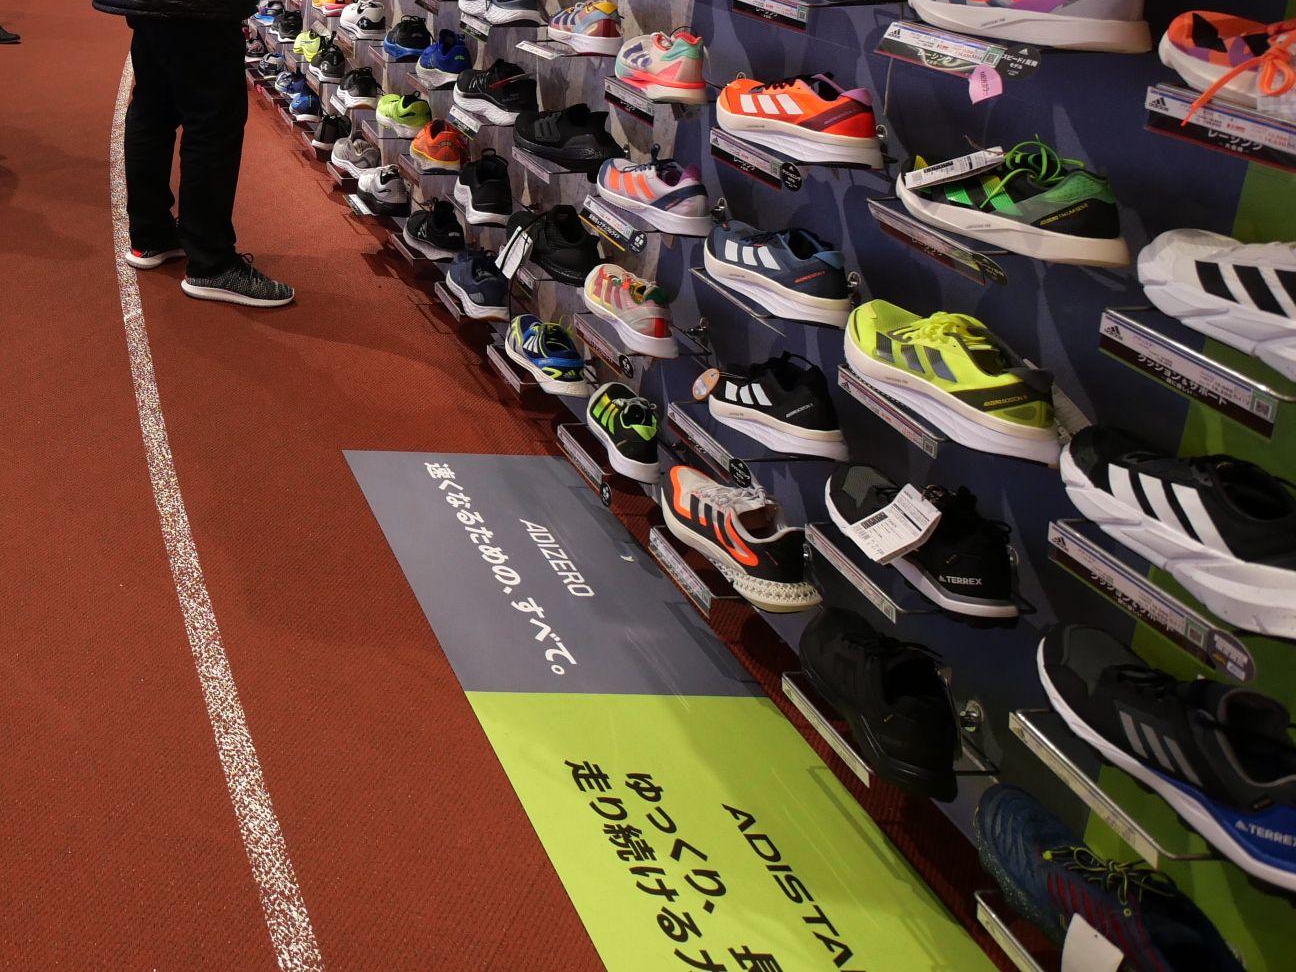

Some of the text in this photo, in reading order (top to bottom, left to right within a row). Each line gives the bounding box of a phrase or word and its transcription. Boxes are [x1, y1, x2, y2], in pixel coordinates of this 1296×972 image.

[916, 49, 953, 64] レーシング
[1207, 129, 1264, 150] レーシング
[519, 518, 595, 597] ADIZERO
[946, 575, 983, 586] TERREX
[721, 803, 868, 972] ADISTA
